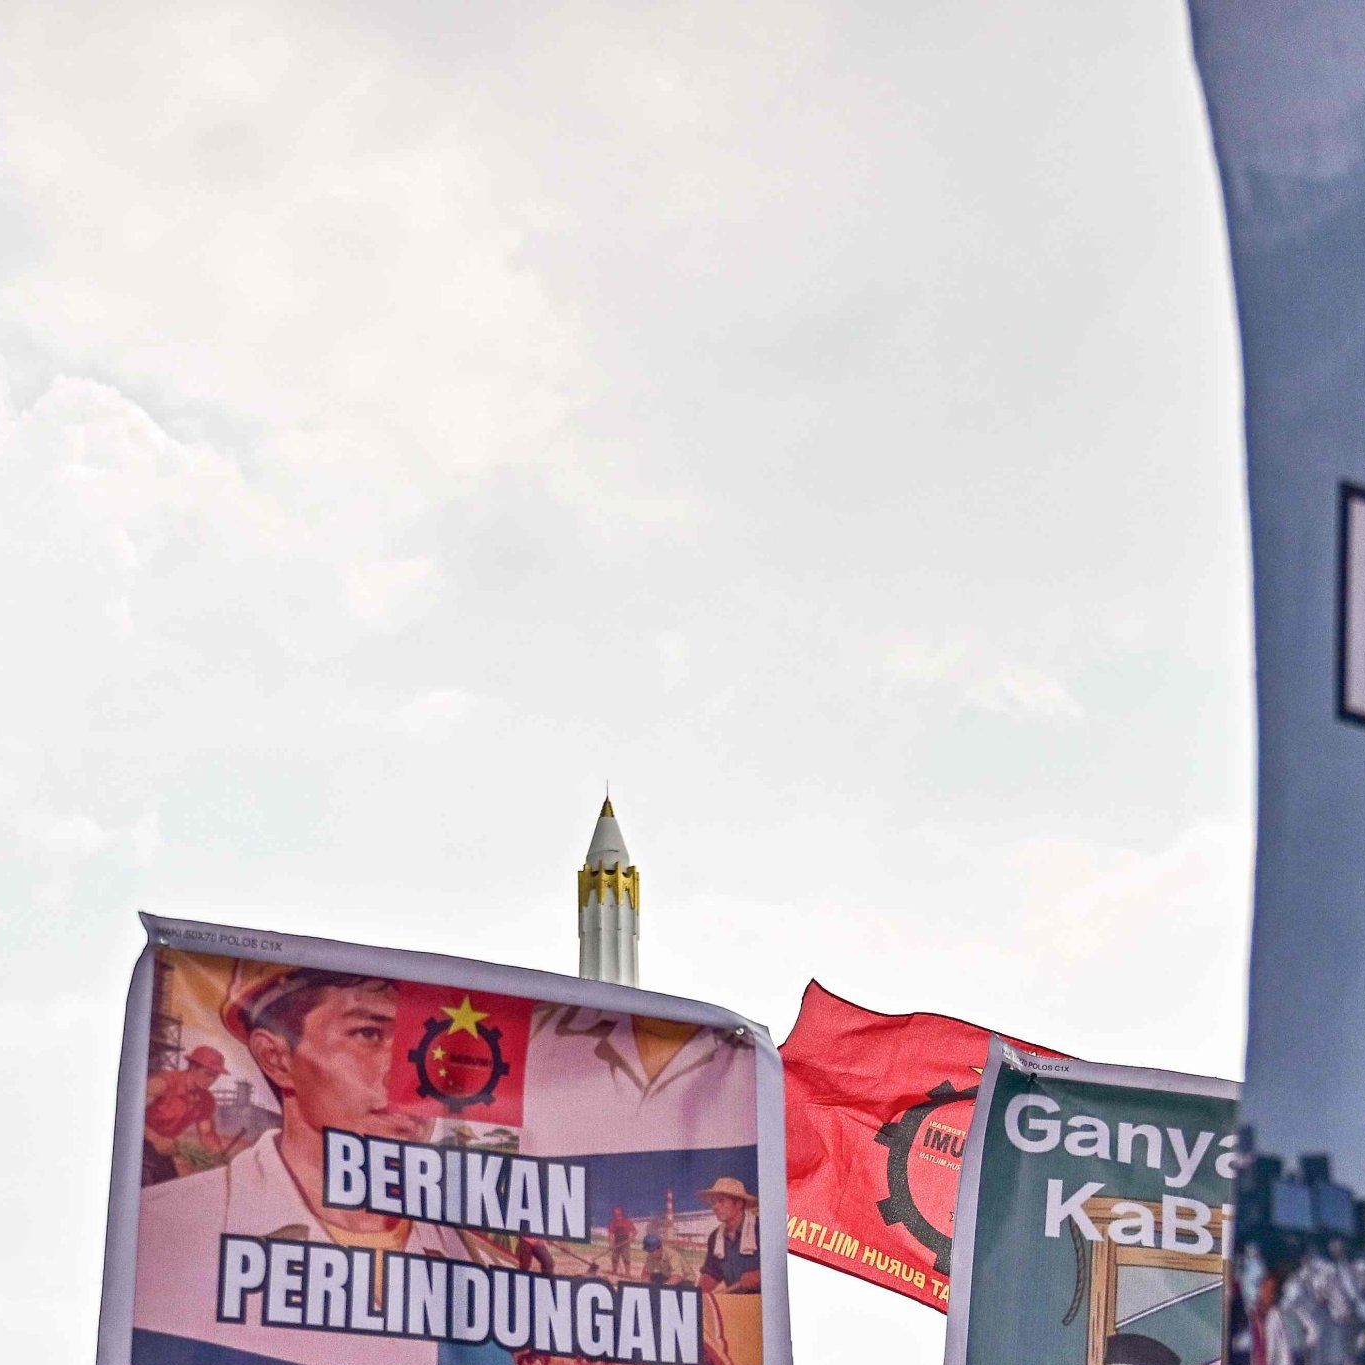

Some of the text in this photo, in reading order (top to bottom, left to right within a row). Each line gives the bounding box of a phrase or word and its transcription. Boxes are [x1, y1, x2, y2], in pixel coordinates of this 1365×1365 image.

[220, 935, 258, 949] POLOS
[1028, 1062, 1053, 1071] POLOS
[326, 1129, 588, 1241] BERIKAN
[219, 1236, 701, 1364] PERLINDUNGAN
